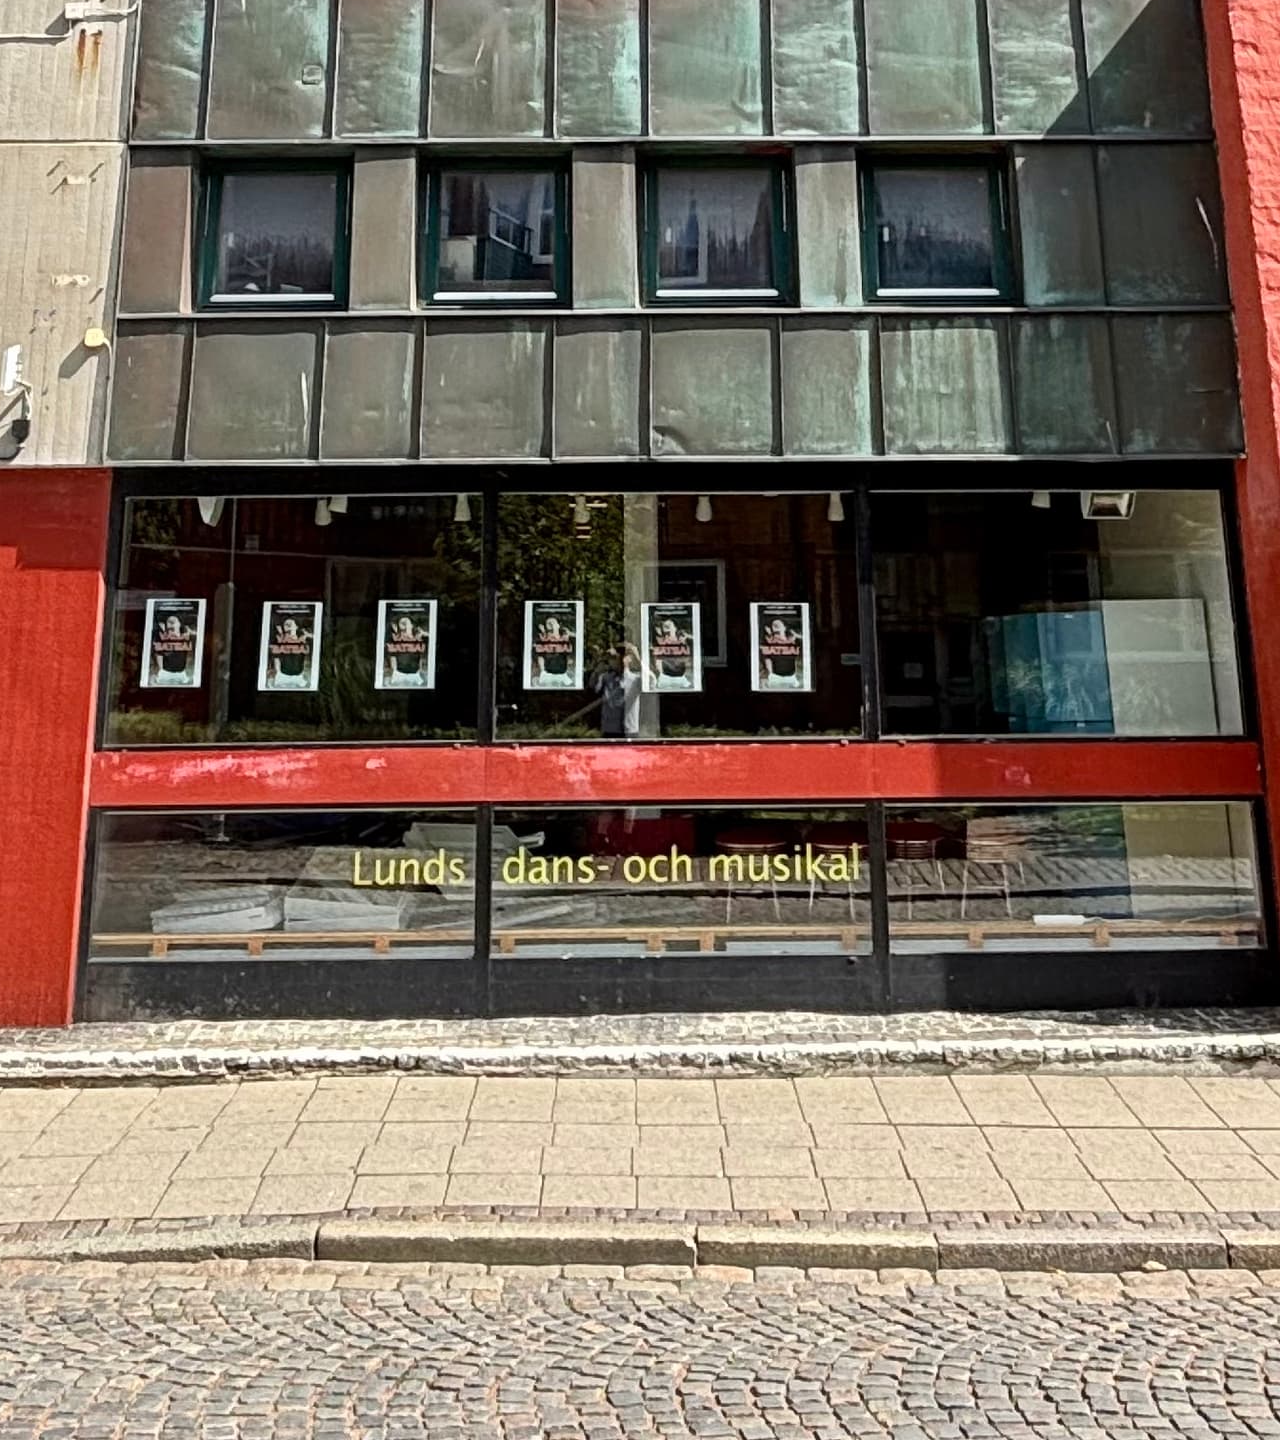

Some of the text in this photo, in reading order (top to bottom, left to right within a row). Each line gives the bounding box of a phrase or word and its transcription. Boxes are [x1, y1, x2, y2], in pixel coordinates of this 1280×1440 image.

[353, 843, 860, 886] Lunds dans- och musikal
